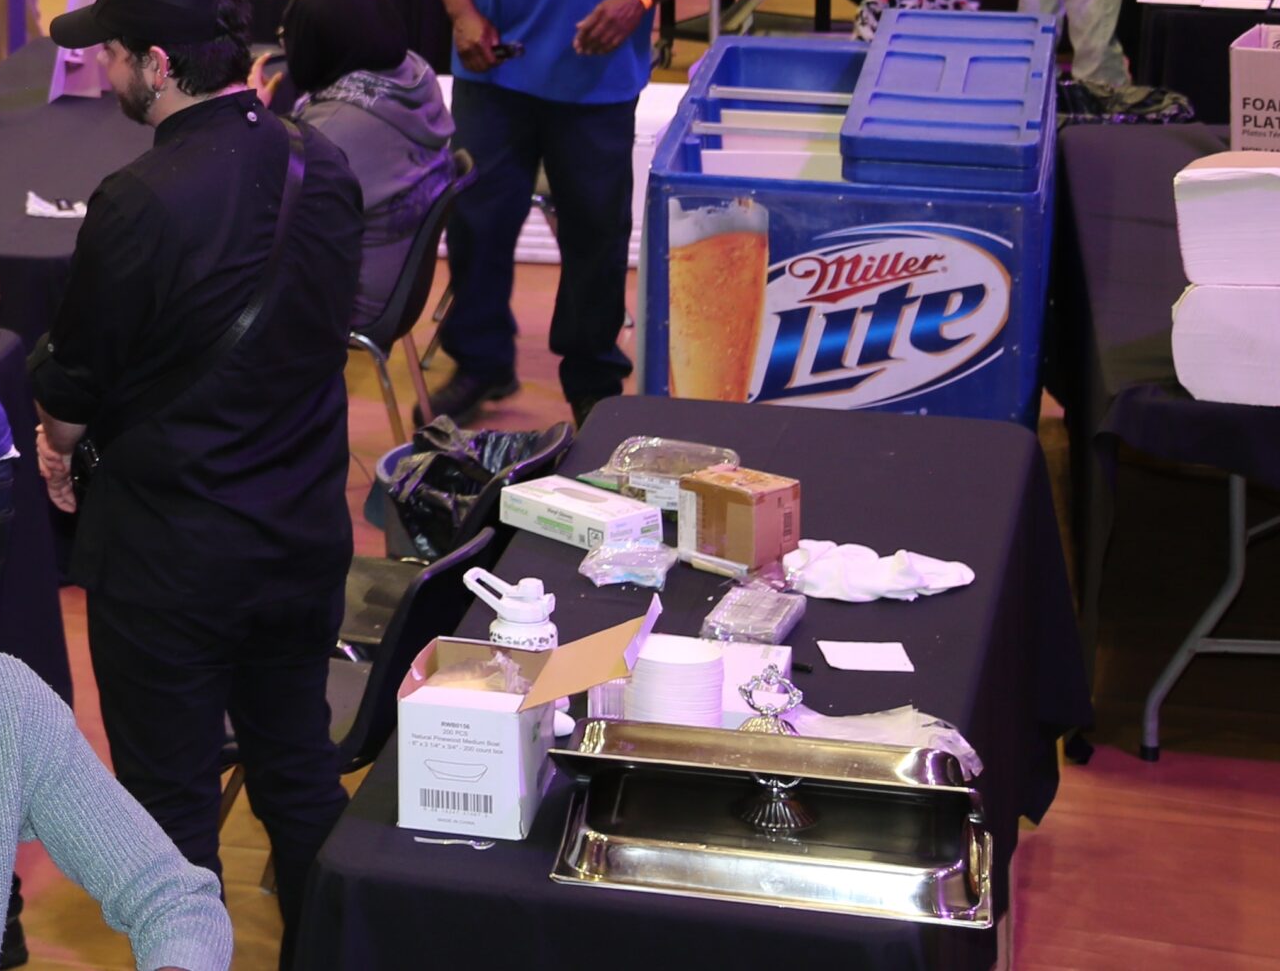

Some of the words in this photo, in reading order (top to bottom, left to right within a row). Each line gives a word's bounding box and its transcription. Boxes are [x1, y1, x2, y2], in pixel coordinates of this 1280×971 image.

[1242, 97, 1280, 112] FOA
[787, 251, 946, 301] Miller
[758, 283, 985, 397] Lite
